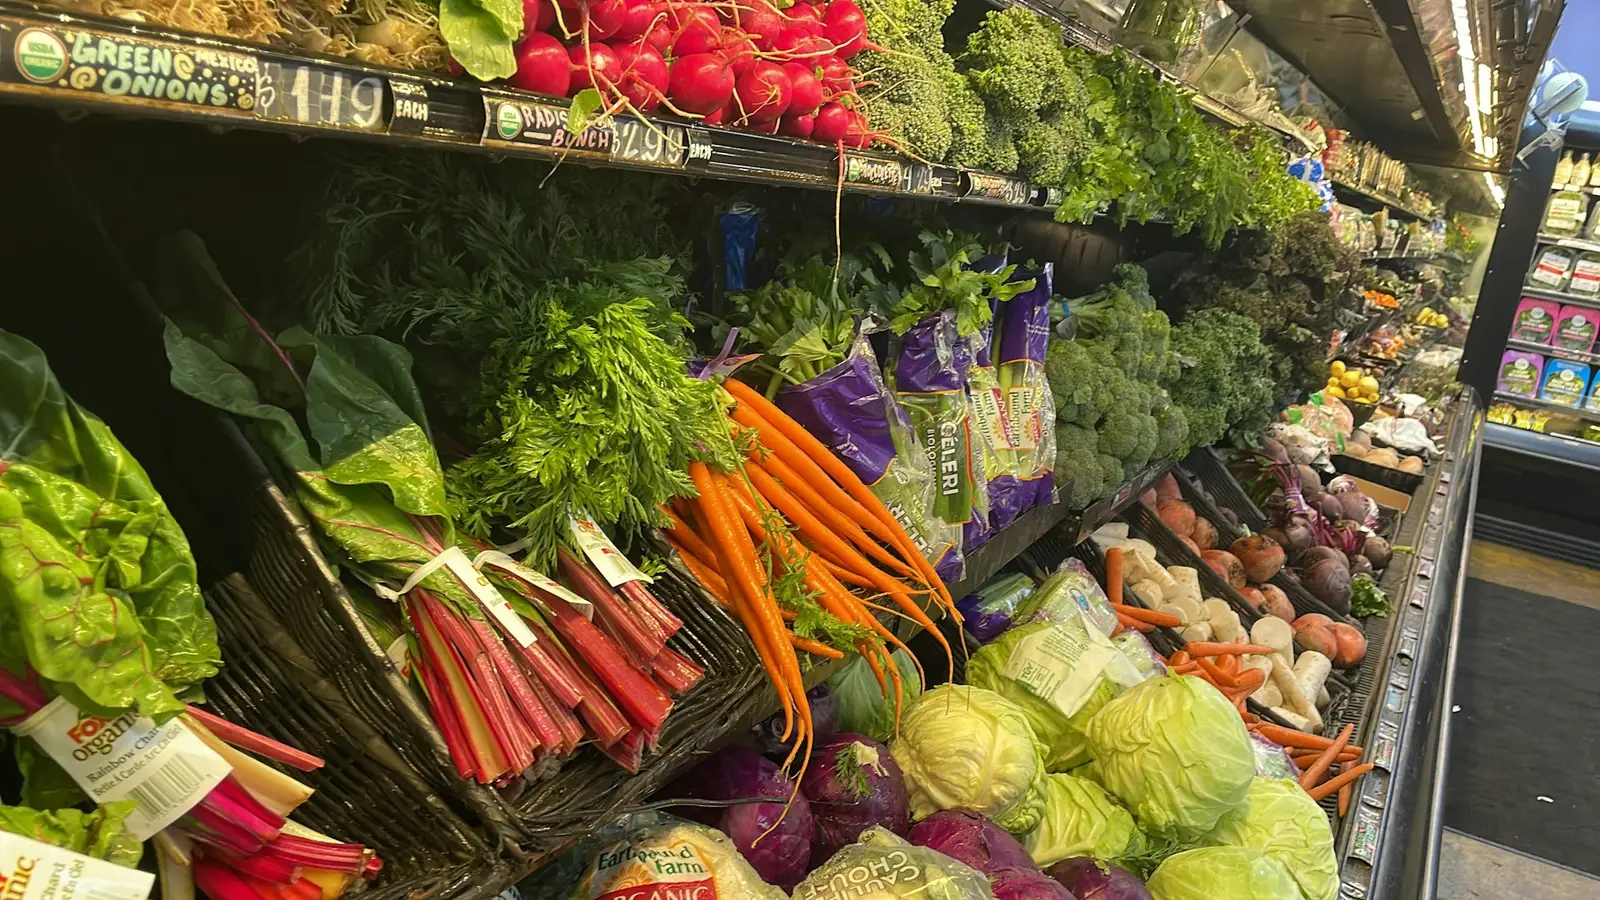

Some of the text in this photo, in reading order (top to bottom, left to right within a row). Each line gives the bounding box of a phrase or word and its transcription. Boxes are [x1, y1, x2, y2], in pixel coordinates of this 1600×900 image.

[72, 32, 173, 77] GREEN
[195, 49, 259, 74] MEXICO
[102, 70, 228, 106] ONIONS
[395, 100, 429, 121] EACH
[520, 105, 568, 131] RADIS
[689, 142, 712, 160] EACH
[1021, 391, 1031, 414] Farm
[969, 393, 994, 446] arthbound
[940, 421, 959, 496] CÉLERI
[1021, 661, 1034, 681] TÜV
[67, 715, 113, 744] FOX
[134, 727, 160, 750] Char
[86, 748, 135, 783] Rainbow
